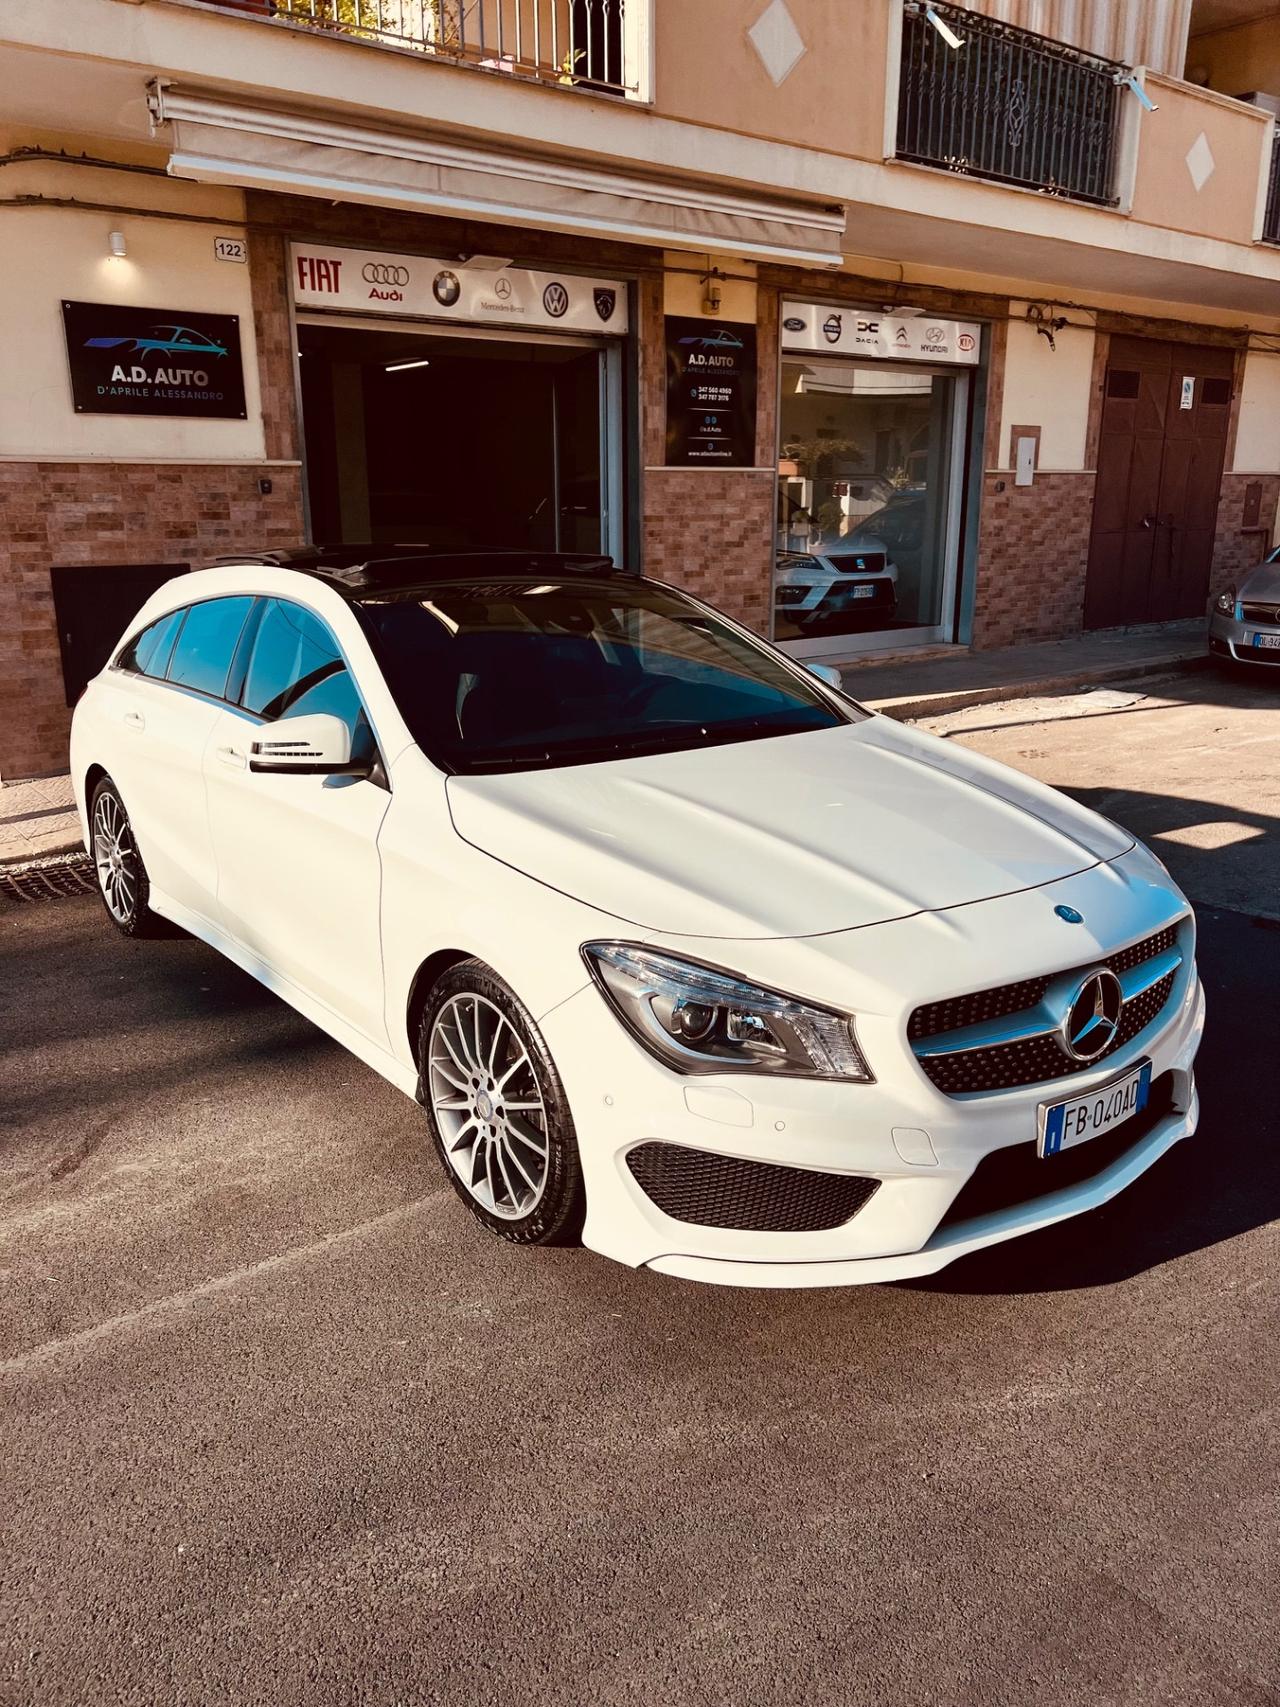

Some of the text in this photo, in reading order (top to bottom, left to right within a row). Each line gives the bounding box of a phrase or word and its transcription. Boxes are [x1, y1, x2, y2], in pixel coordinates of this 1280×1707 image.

[218, 243, 241, 257] 122
[297, 256, 342, 294] FIAT
[368, 287, 403, 302] Audi
[480, 302, 525, 314] Mercedes-Benz
[855, 337, 879, 345] DACIA
[960, 338, 972, 347] KIA
[920, 344, 949, 353] HYUNDAI
[688, 353, 734, 367] A.D. AUTO
[111, 365, 209, 387] A.D. AUTO
[97, 386, 224, 401] D'APRILE ALESSANDRO
